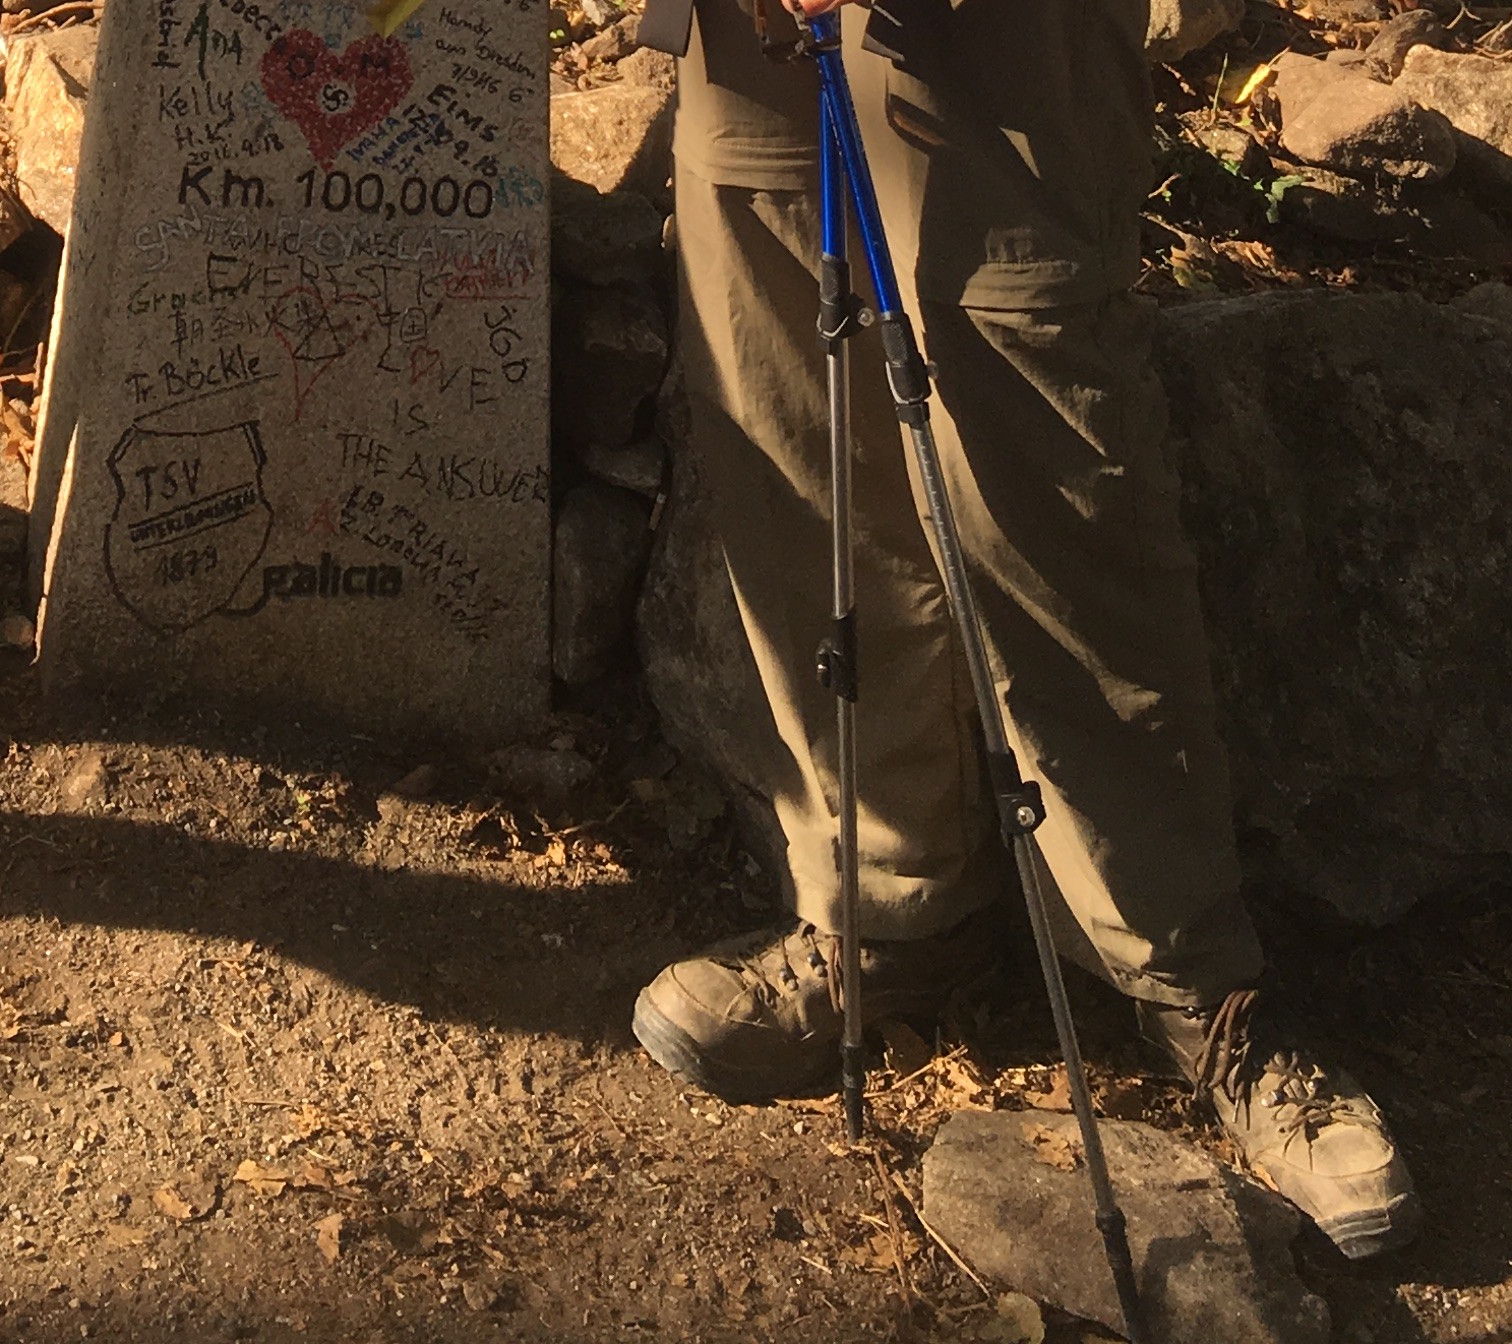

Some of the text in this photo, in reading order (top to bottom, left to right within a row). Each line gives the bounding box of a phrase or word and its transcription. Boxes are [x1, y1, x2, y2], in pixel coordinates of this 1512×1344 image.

[178, 163, 275, 209] Km.
[296, 165, 492, 221] 100,000
[158, 343, 261, 396] Böckle
[392, 398, 431, 436] IS
[337, 432, 393, 478] THE
[134, 458, 201, 512] TSV
